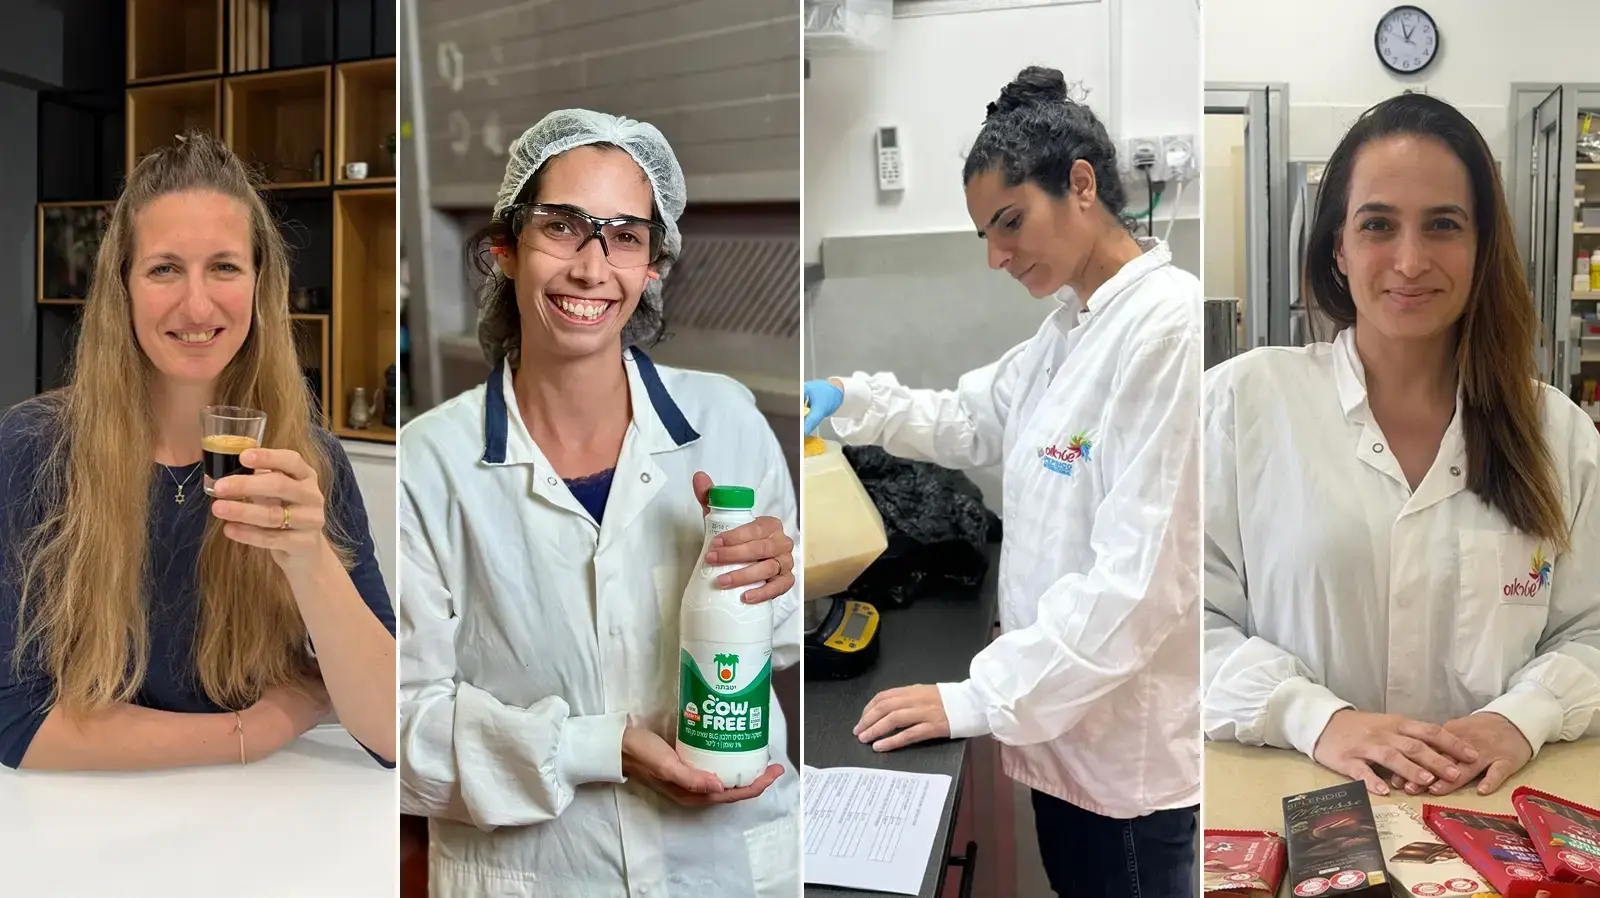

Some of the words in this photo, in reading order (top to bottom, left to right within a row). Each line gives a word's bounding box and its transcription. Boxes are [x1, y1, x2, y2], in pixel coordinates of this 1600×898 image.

[1403, 12, 1411, 20] 12
[1423, 25, 1430, 33] 2
[1426, 37, 1432, 45] 3
[1384, 48, 1391, 56] 8
[1046, 445, 1074, 462] שטראוס
[1504, 578, 1536, 597] שטראוס
[702, 696, 748, 716] COW
[702, 714, 746, 731] FREE
[1287, 791, 1348, 809] SPLENDID
[1288, 799, 1364, 820] Mousse
